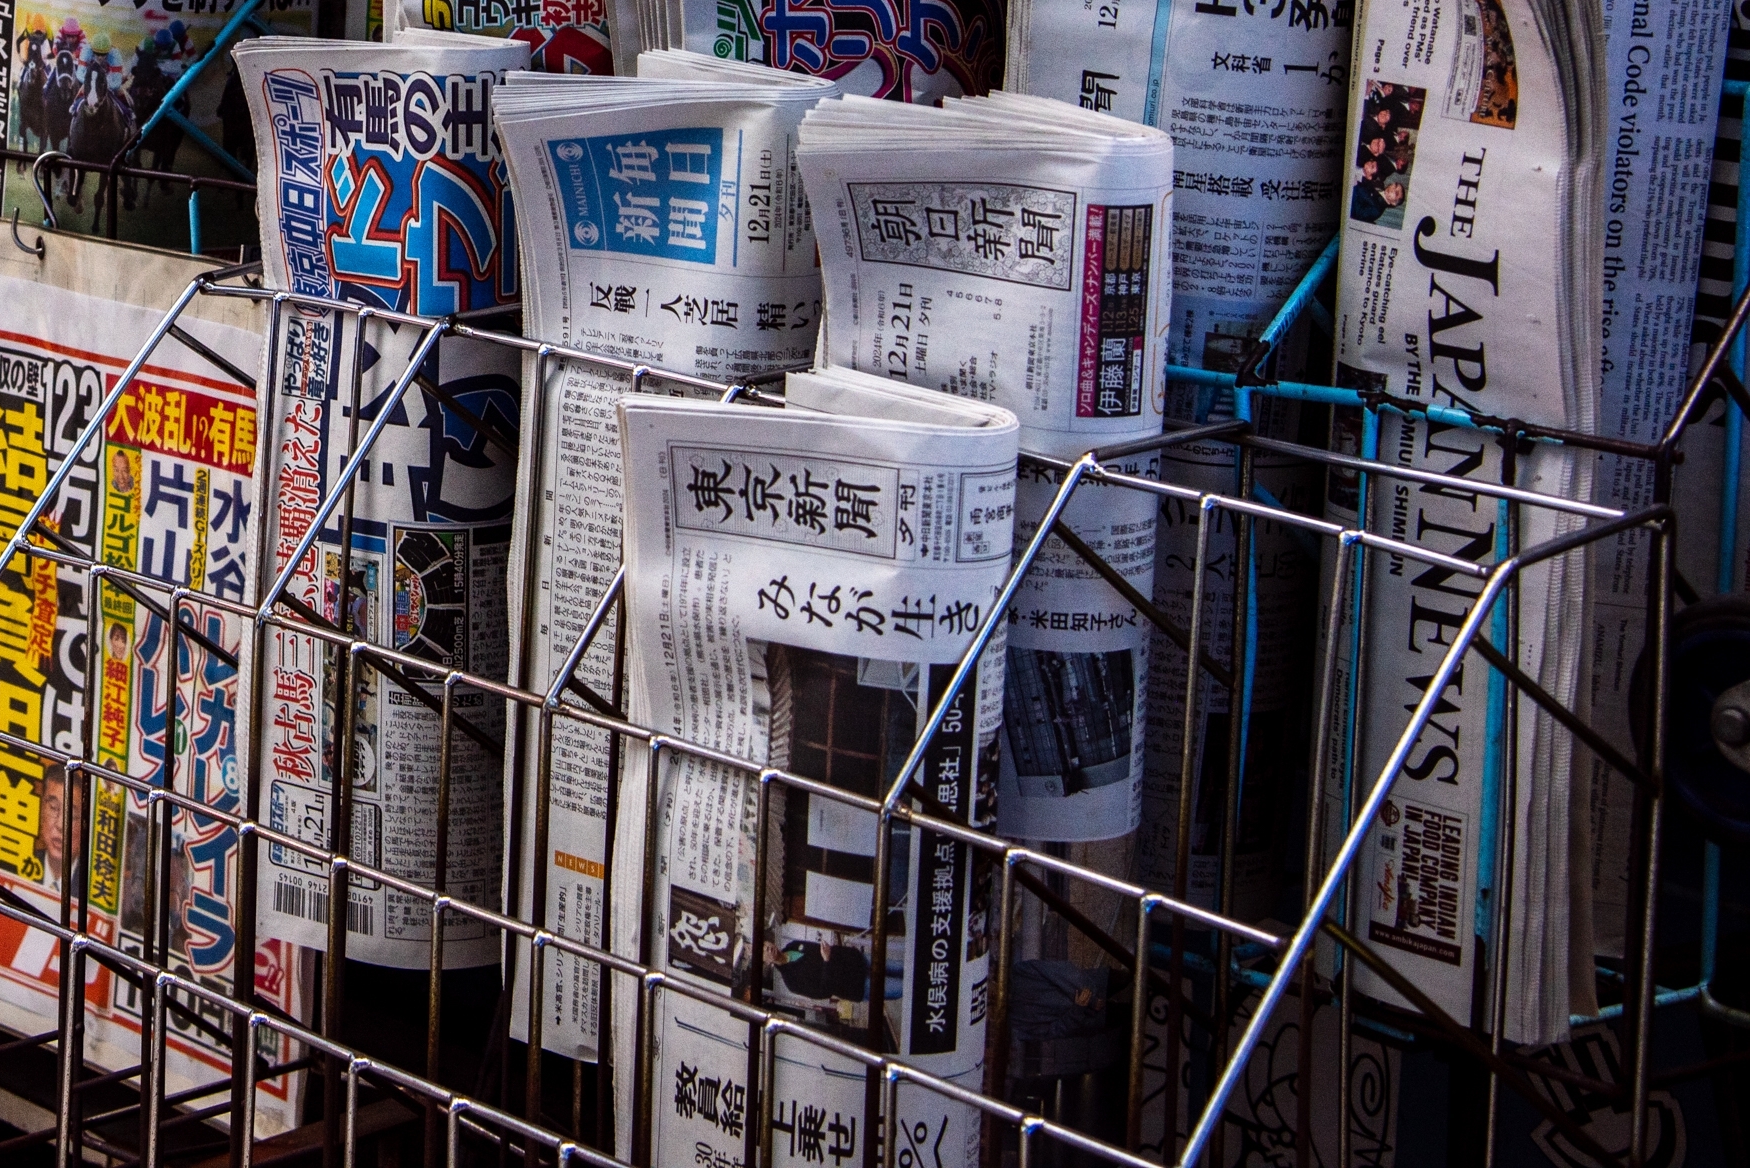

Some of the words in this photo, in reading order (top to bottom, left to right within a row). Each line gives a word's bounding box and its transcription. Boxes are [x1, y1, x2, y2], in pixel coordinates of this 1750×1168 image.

[1210, 51, 1273, 76] 文科省
[1621, 43, 1647, 108] Code
[569, 164, 590, 217] MAINICHI
[1449, 146, 1488, 240] THE
[1608, 110, 1642, 213] violators
[720, 178, 737, 223] 夕刊
[747, 148, 774, 245] 12月21日(土)
[870, 196, 1065, 266] 朝日新聞
[1606, 216, 1625, 248] on
[1102, 272, 1117, 296] 京都
[1117, 272, 1130, 296] 神戸
[1129, 271, 1143, 295] 東京
[1602, 250, 1626, 292] the
[587, 281, 740, 331] 反戦一人芝居
[887, 282, 914, 380] 12月21日
[917, 296, 933, 328] 夕刊
[283, 318, 306, 397] やっぱり
[914, 333, 930, 376] 土曜日
[1096, 336, 1127, 416] 伊藤蘭
[1403, 333, 1419, 355] BY
[1412, 214, 1502, 497] JAPAN
[1401, 358, 1418, 396] THE
[107, 384, 258, 470] 大波乱!?有馬
[138, 459, 196, 585] 片山
[686, 459, 883, 540] 東京新聞
[899, 483, 917, 548] 夕刊
[921, 475, 934, 543] 中日新聞東京本社
[756, 574, 982, 642] みなが生き
[1402, 514, 1497, 788] NEWS
[101, 658, 127, 751] 細江純子
[1426, 810, 1444, 849] FOOD
[1446, 814, 1464, 884] LEADING
[554, 850, 606, 880] NEWS
[1418, 852, 1438, 935] COMPANY
[1443, 886, 1460, 941] INDIAN
